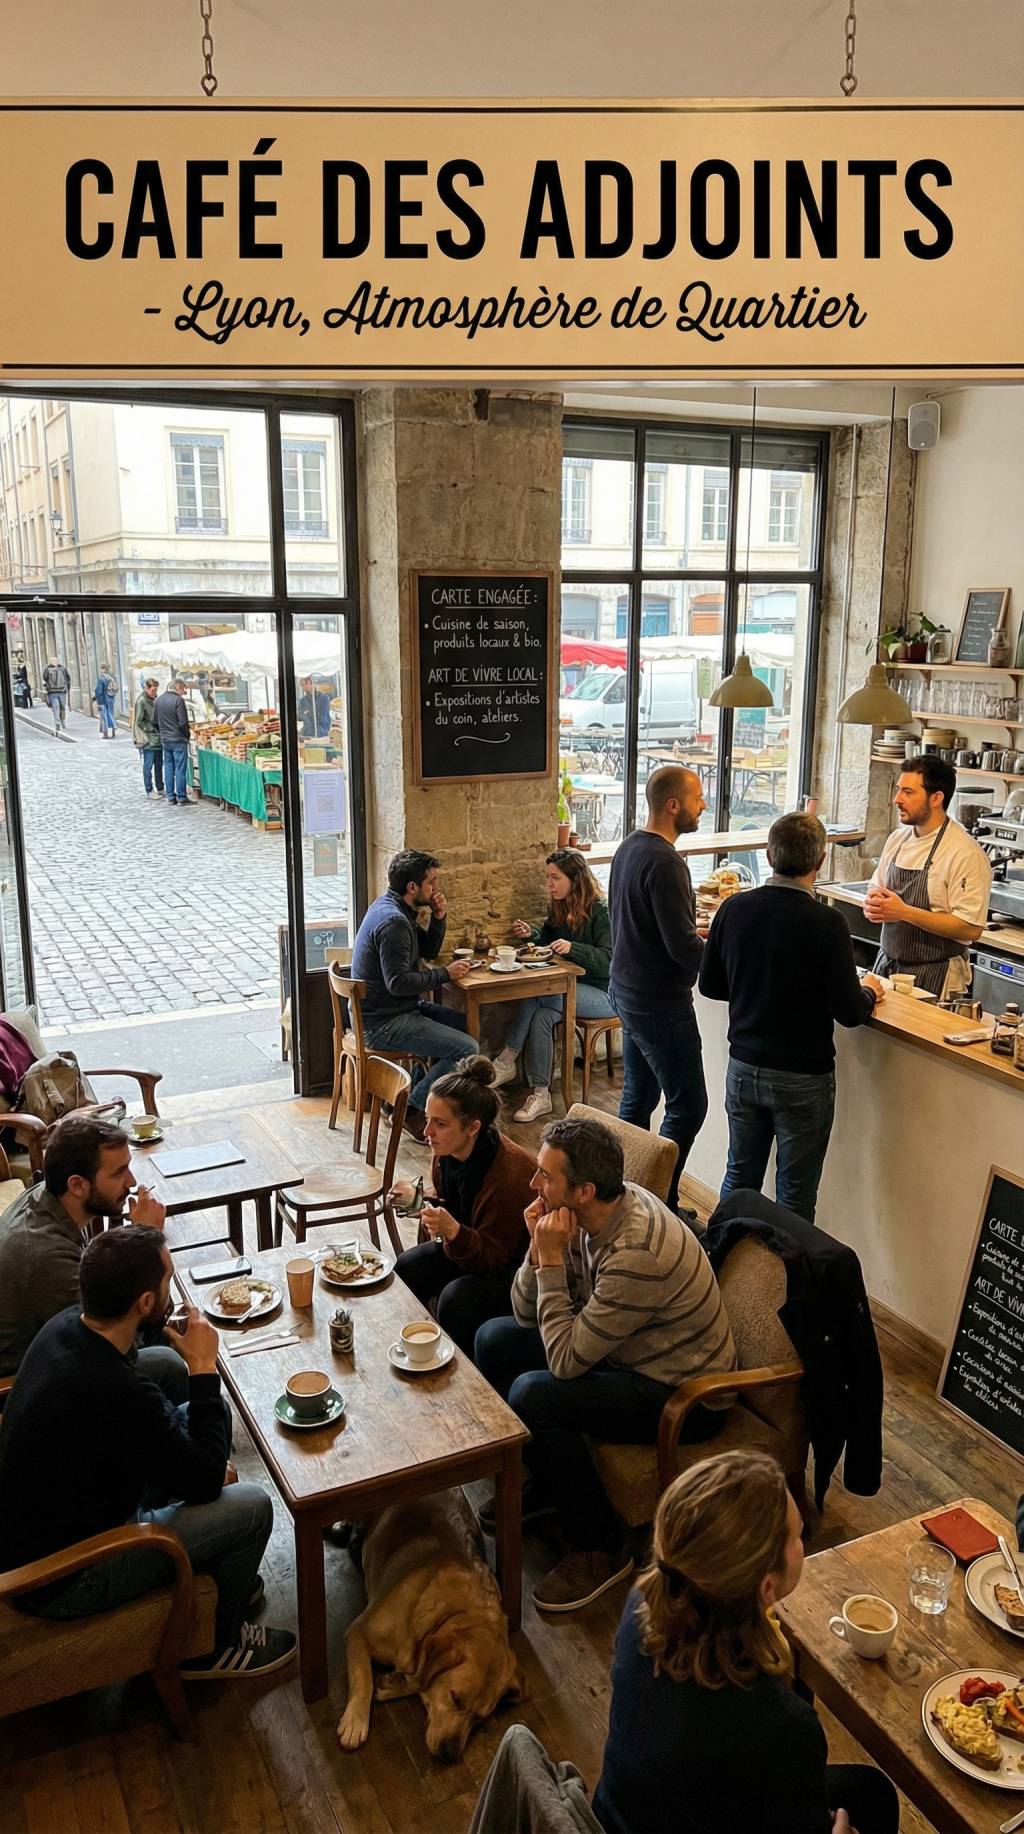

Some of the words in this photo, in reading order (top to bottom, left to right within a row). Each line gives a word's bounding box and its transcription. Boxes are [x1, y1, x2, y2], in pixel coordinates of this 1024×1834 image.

[64, 137, 283, 261] CAFÉ
[322, 158, 486, 261] DES
[519, 158, 954, 261] ADJOINTS
[174, 279, 311, 345] Lyon,
[323, 280, 602, 340] Atmosphère
[610, 286, 668, 329] de
[675, 280, 868, 343] Quartier
[431, 588, 472, 605] CARTE
[432, 615, 472, 630] Cuisine
[476, 615, 489, 630] de
[494, 618, 530, 632] saison,
[433, 633, 475, 654] produits
[479, 633, 510, 648] locaux
[513, 632, 521, 648] &
[524, 631, 542, 648] bio.
[428, 667, 451, 684] ART
[455, 667, 469, 682] DE
[434, 691, 492, 712] Expositions
[495, 690, 540, 706] d'artistes
[435, 710, 449, 725] du
[453, 711, 477, 726] coin,
[481, 708, 522, 723] ateliers.
[989, 1217, 1018, 1242] CARTE
[974, 1276, 993, 1295] ART
[993, 1286, 1006, 1304] DE
